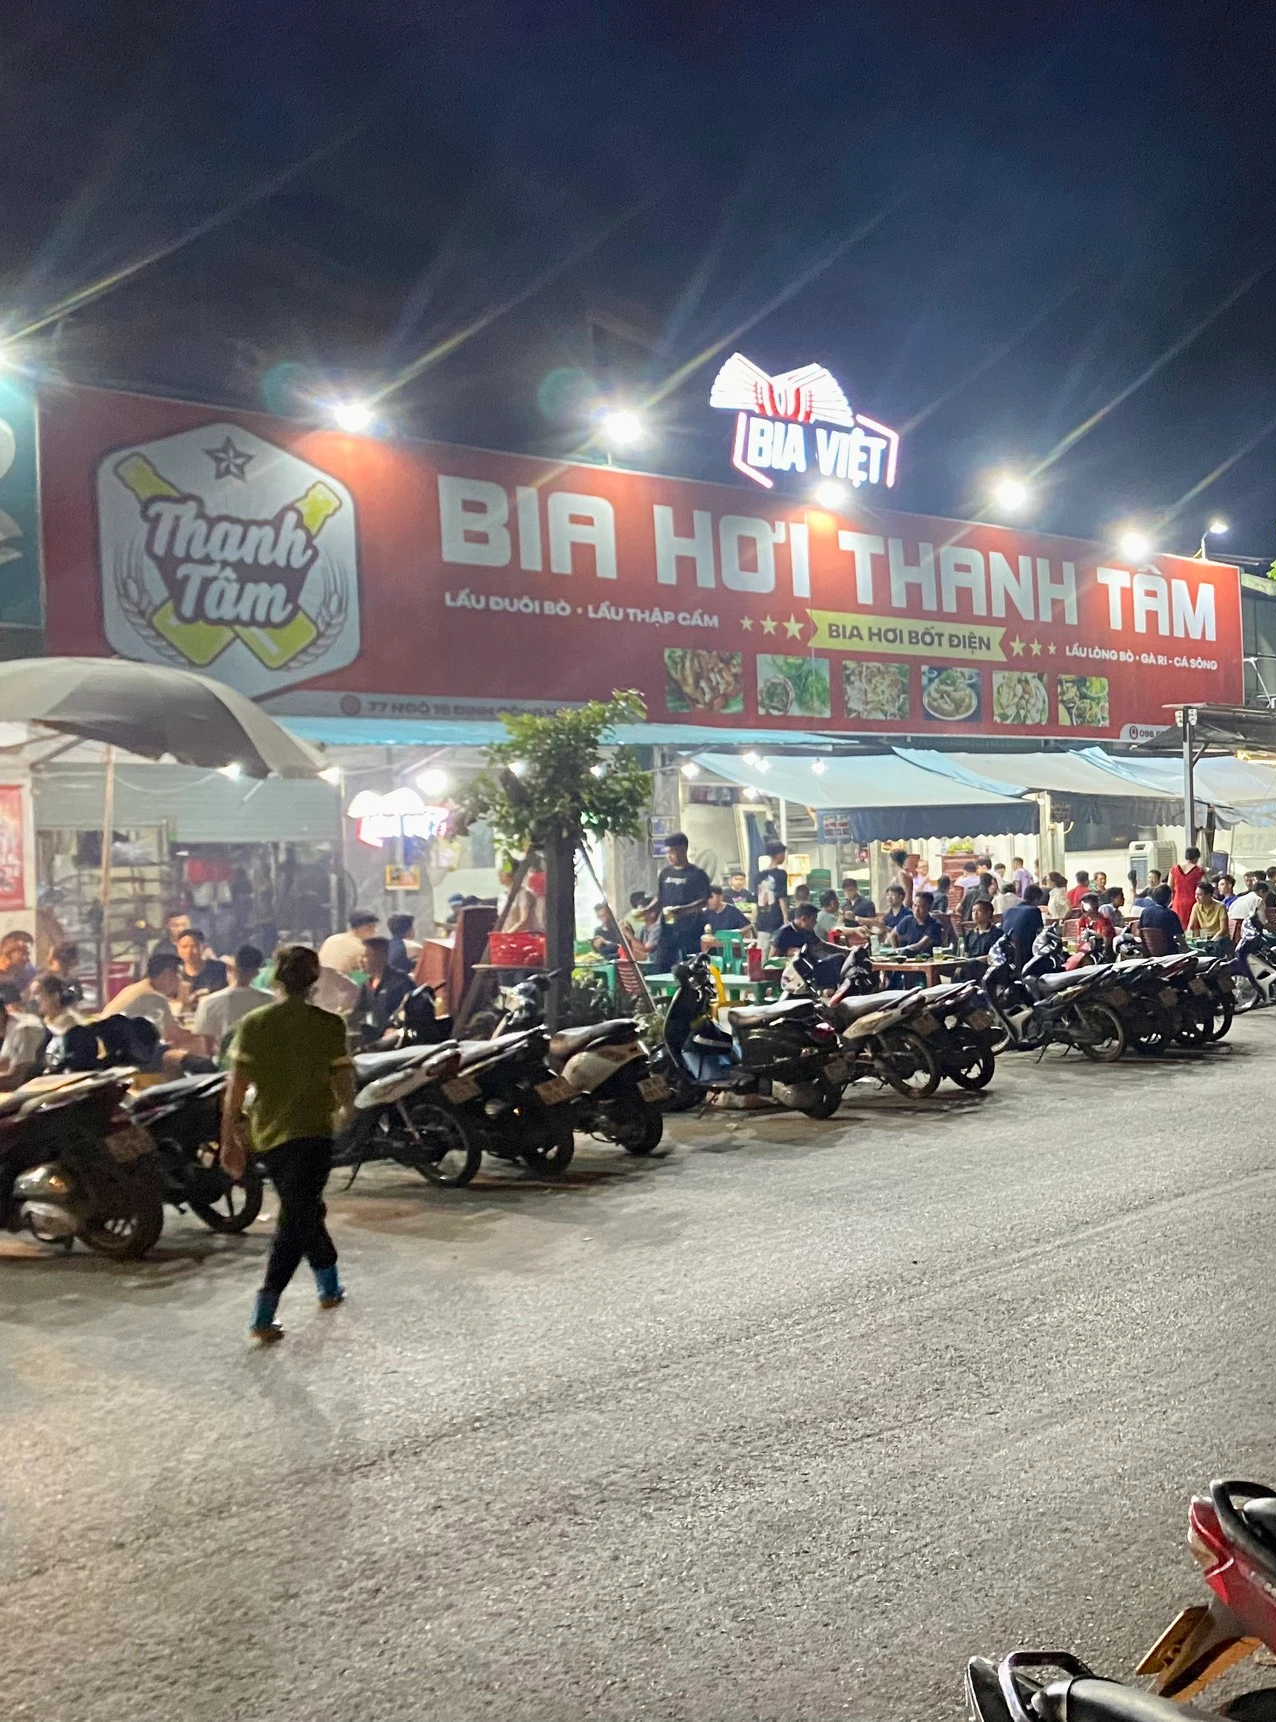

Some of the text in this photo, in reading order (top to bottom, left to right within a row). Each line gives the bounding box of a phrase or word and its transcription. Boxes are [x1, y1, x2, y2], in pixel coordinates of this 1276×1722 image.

[747, 416, 888, 488] BIA VIỆT
[147, 501, 313, 569] Thanh
[437, 474, 1217, 642] BIA HƠI THANH TÂM
[175, 562, 294, 624] Tâm
[543, 598, 573, 617] BÒ
[626, 607, 675, 628] THẬP
[827, 622, 991, 654] BIA HƠI BỐT ĐIỆN
[1088, 646, 1118, 661] LÒNG
[1119, 649, 1135, 663] BÒ
[1140, 651, 1157, 665] GÀ
[1157, 654, 1168, 666] RI
[1173, 655, 1189, 668] CÁ
[1190, 656, 1219, 671] SÔNG
[369, 701, 388, 713] 77
